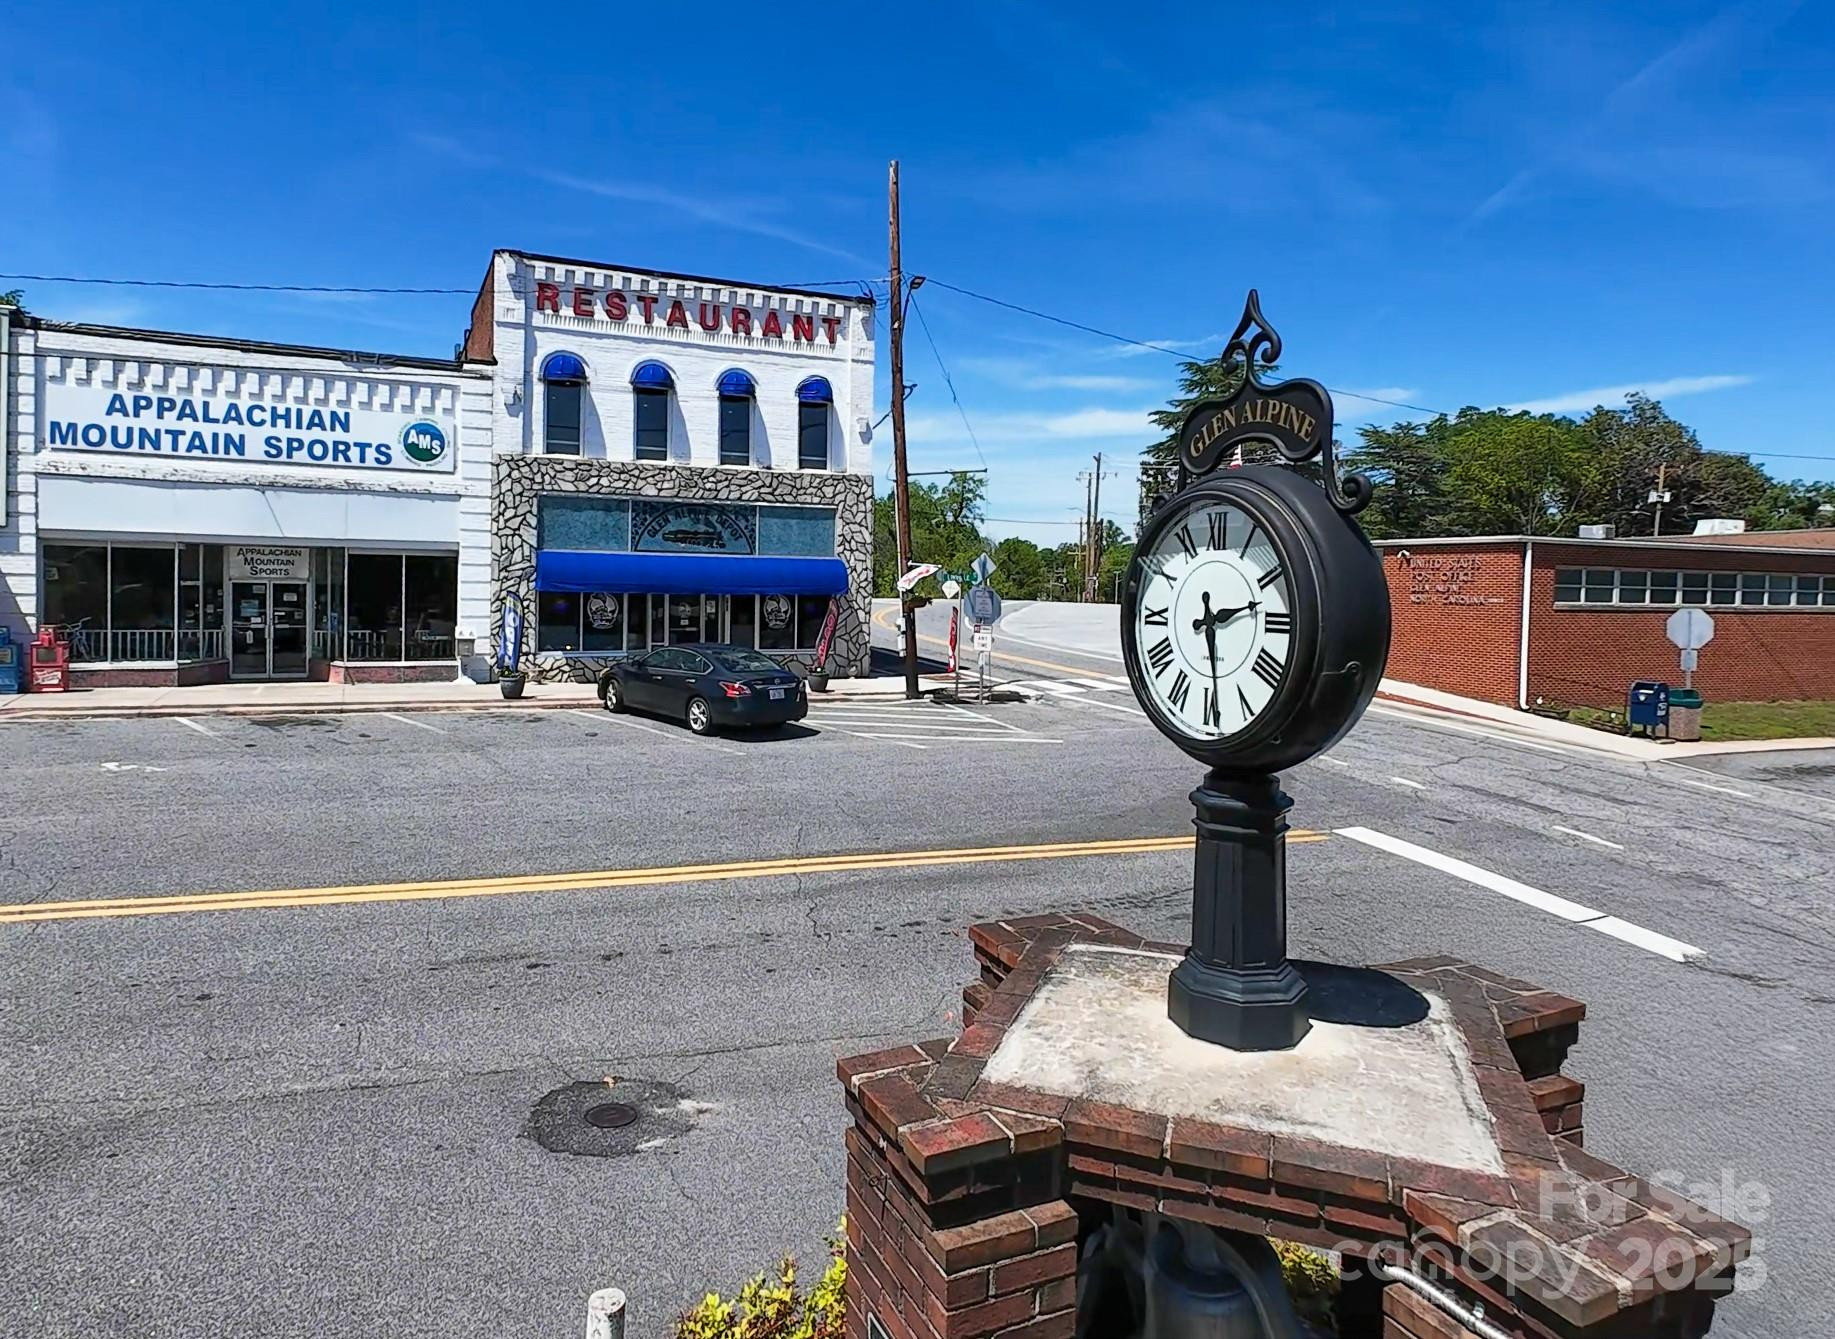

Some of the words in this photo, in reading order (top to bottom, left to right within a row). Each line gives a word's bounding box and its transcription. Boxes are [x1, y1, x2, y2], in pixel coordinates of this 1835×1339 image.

[536, 281, 843, 345] RESTAURANT
[105, 393, 352, 434] APPALACHIAN
[1190, 405, 1237, 457] GLEN
[1240, 399, 1316, 442] ALPINE
[50, 420, 246, 457] MOUNTAIN
[264, 436, 392, 465] SPORTS
[407, 428, 442, 455] AMS
[646, 514, 671, 538] GLEN
[715, 514, 743, 541] DEPOT
[1174, 523, 1198, 564] XI
[1206, 512, 1228, 551] XII
[236, 547, 302, 557] APPALACHIAN
[243, 557, 295, 566] MOUNTAIN
[250, 566, 290, 576] SPORTS
[1410, 558, 1442, 569] UNITED
[1449, 559, 1482, 569] STATES
[1144, 605, 1169, 626] IX
[1264, 612, 1291, 634] III
[1147, 636, 1175, 680] VIII
[1167, 669, 1192, 713] VII
[1236, 684, 1255, 722] V
